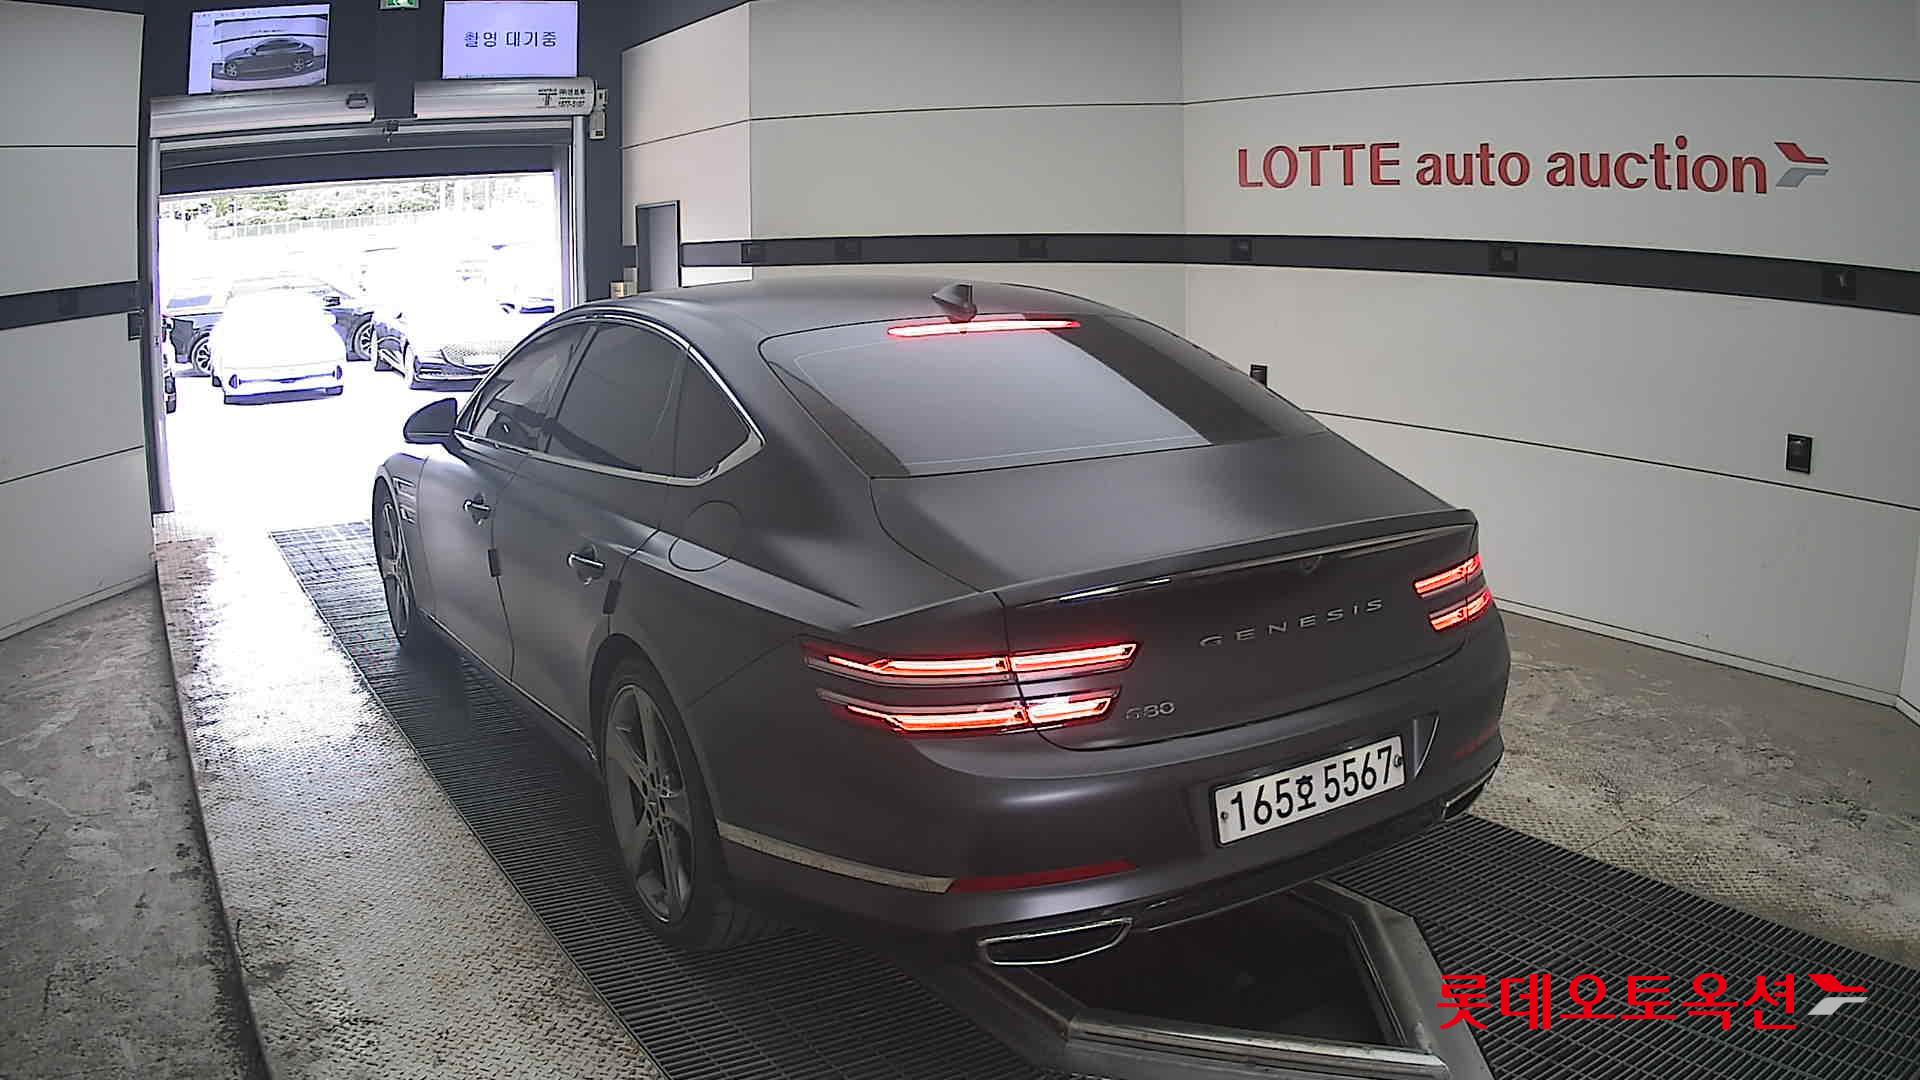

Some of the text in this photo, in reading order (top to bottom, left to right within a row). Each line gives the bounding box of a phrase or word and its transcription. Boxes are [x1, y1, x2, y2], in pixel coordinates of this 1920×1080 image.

[1238, 135, 1768, 194] LOTTE auto auction
[1199, 599, 1384, 646] GENESIS
[1323, 745, 1393, 804] 5567
